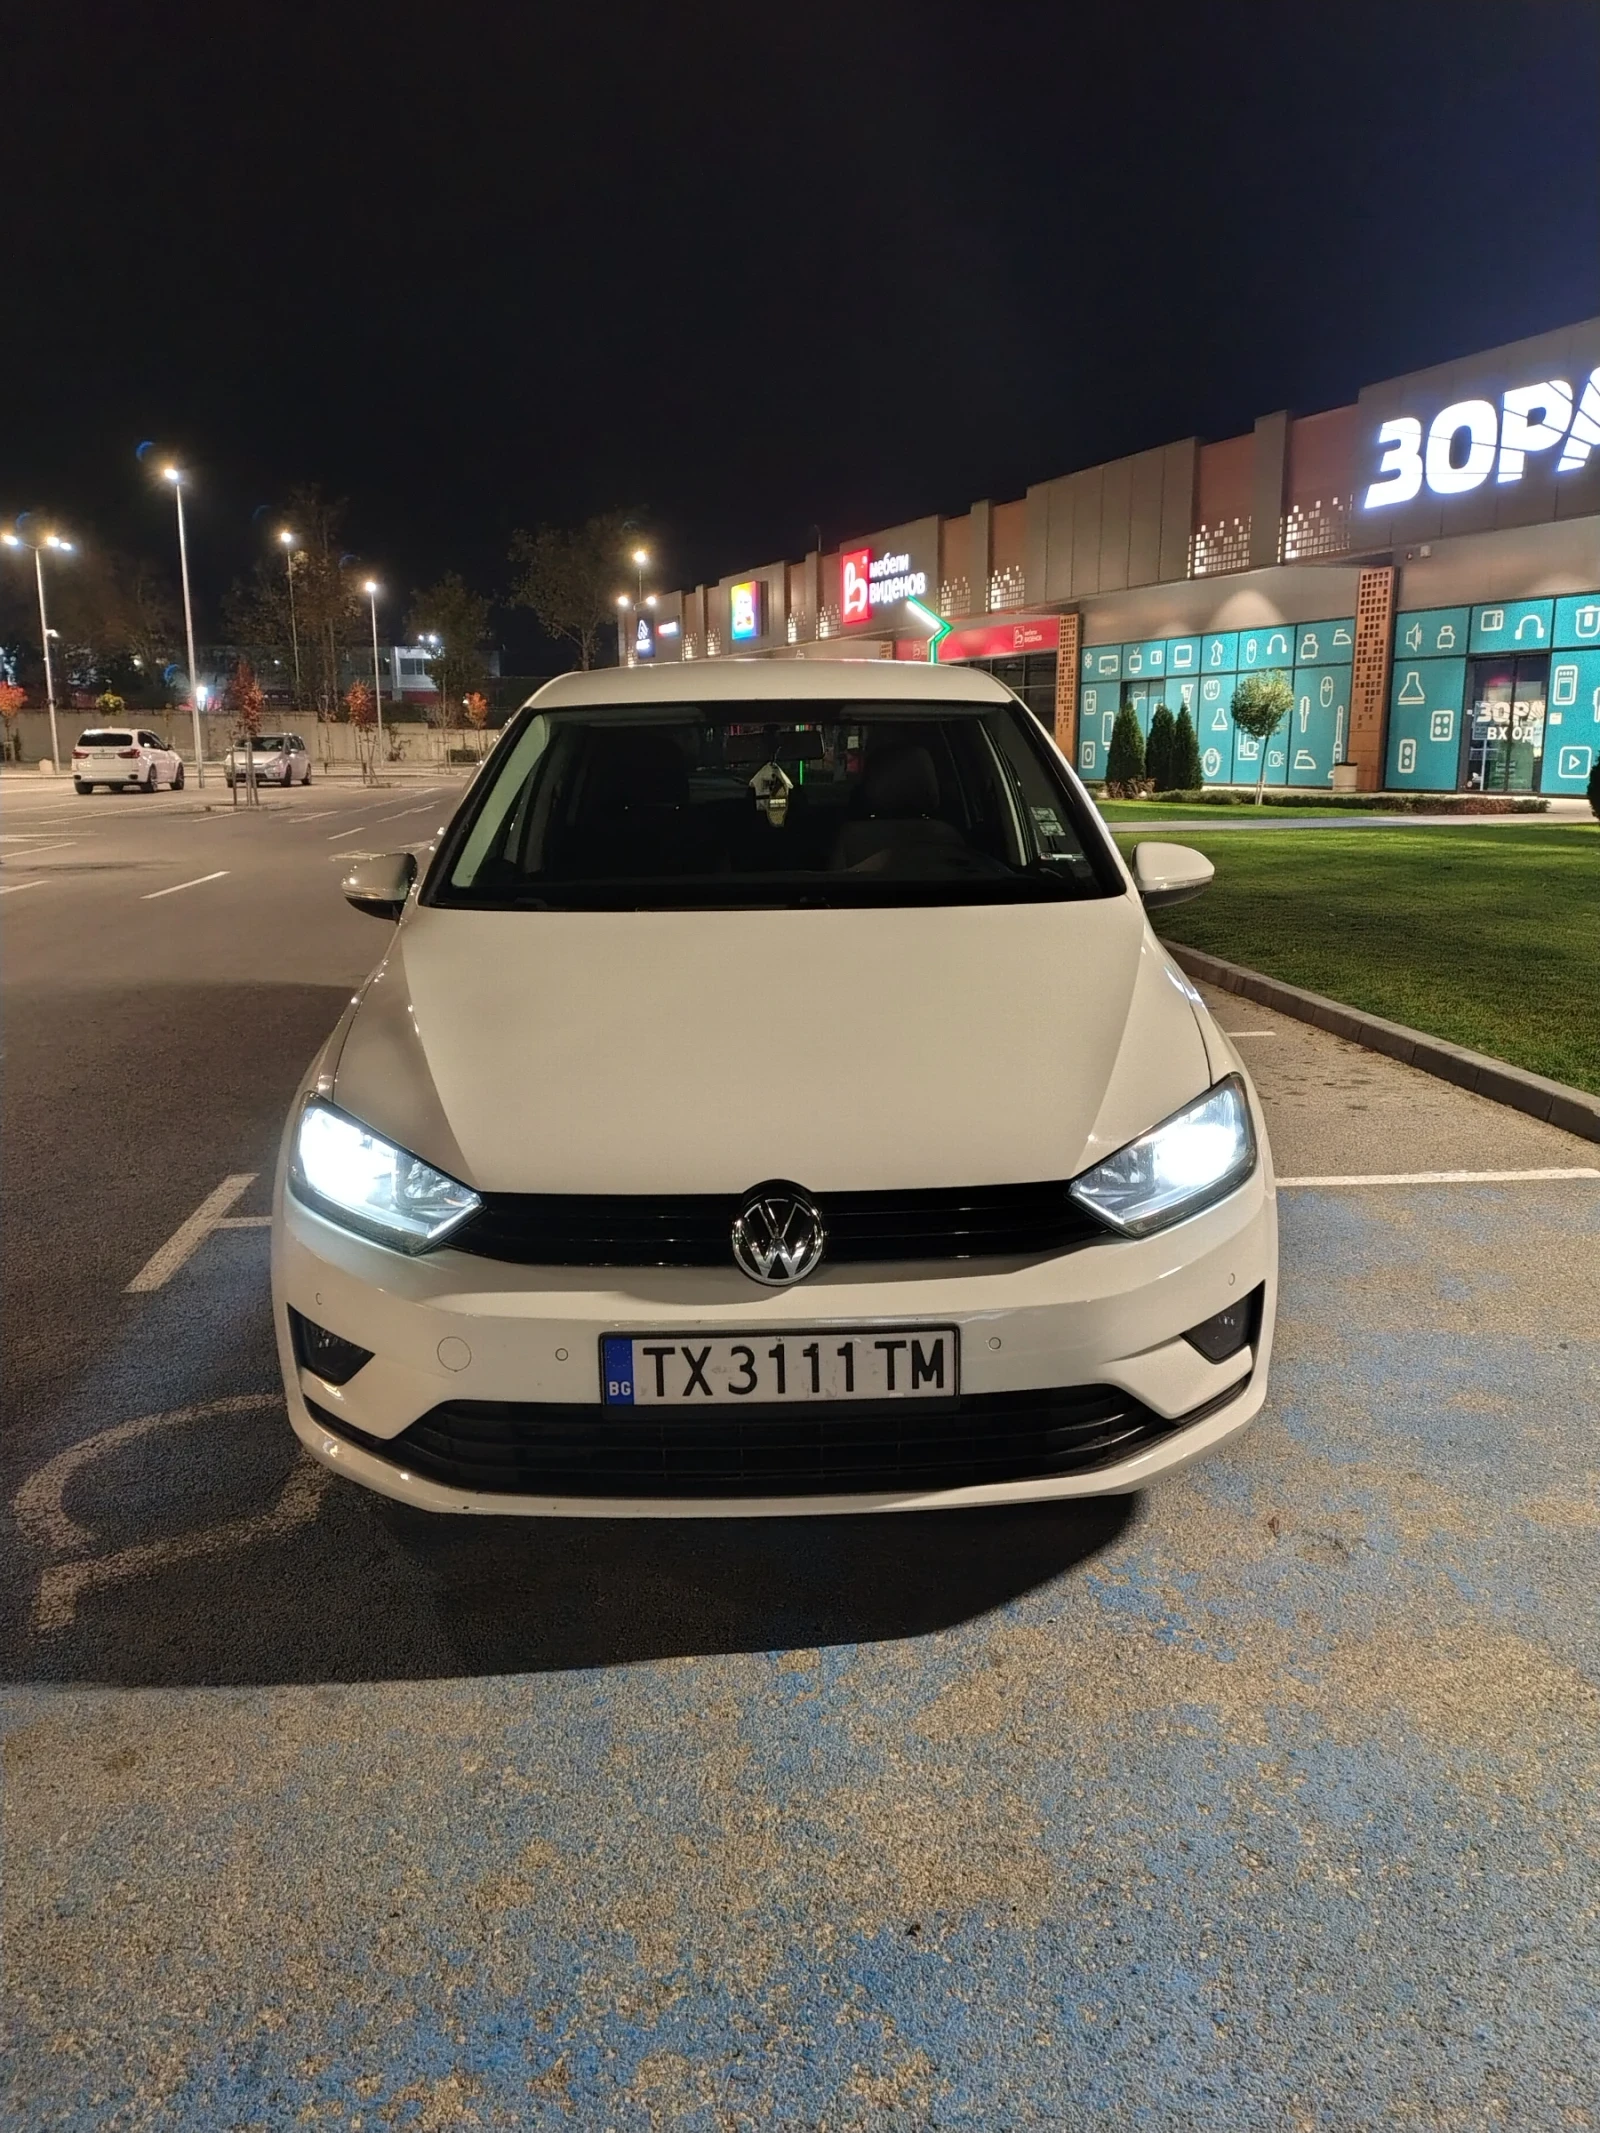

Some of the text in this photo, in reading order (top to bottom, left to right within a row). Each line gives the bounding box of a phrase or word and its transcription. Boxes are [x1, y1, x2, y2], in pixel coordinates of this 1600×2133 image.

[869, 552, 909, 578] мебели
[1487, 726, 1534, 743] ВХОД
[643, 1338, 944, 1397] TX 3111 TM
[608, 1381, 632, 1396] BG
